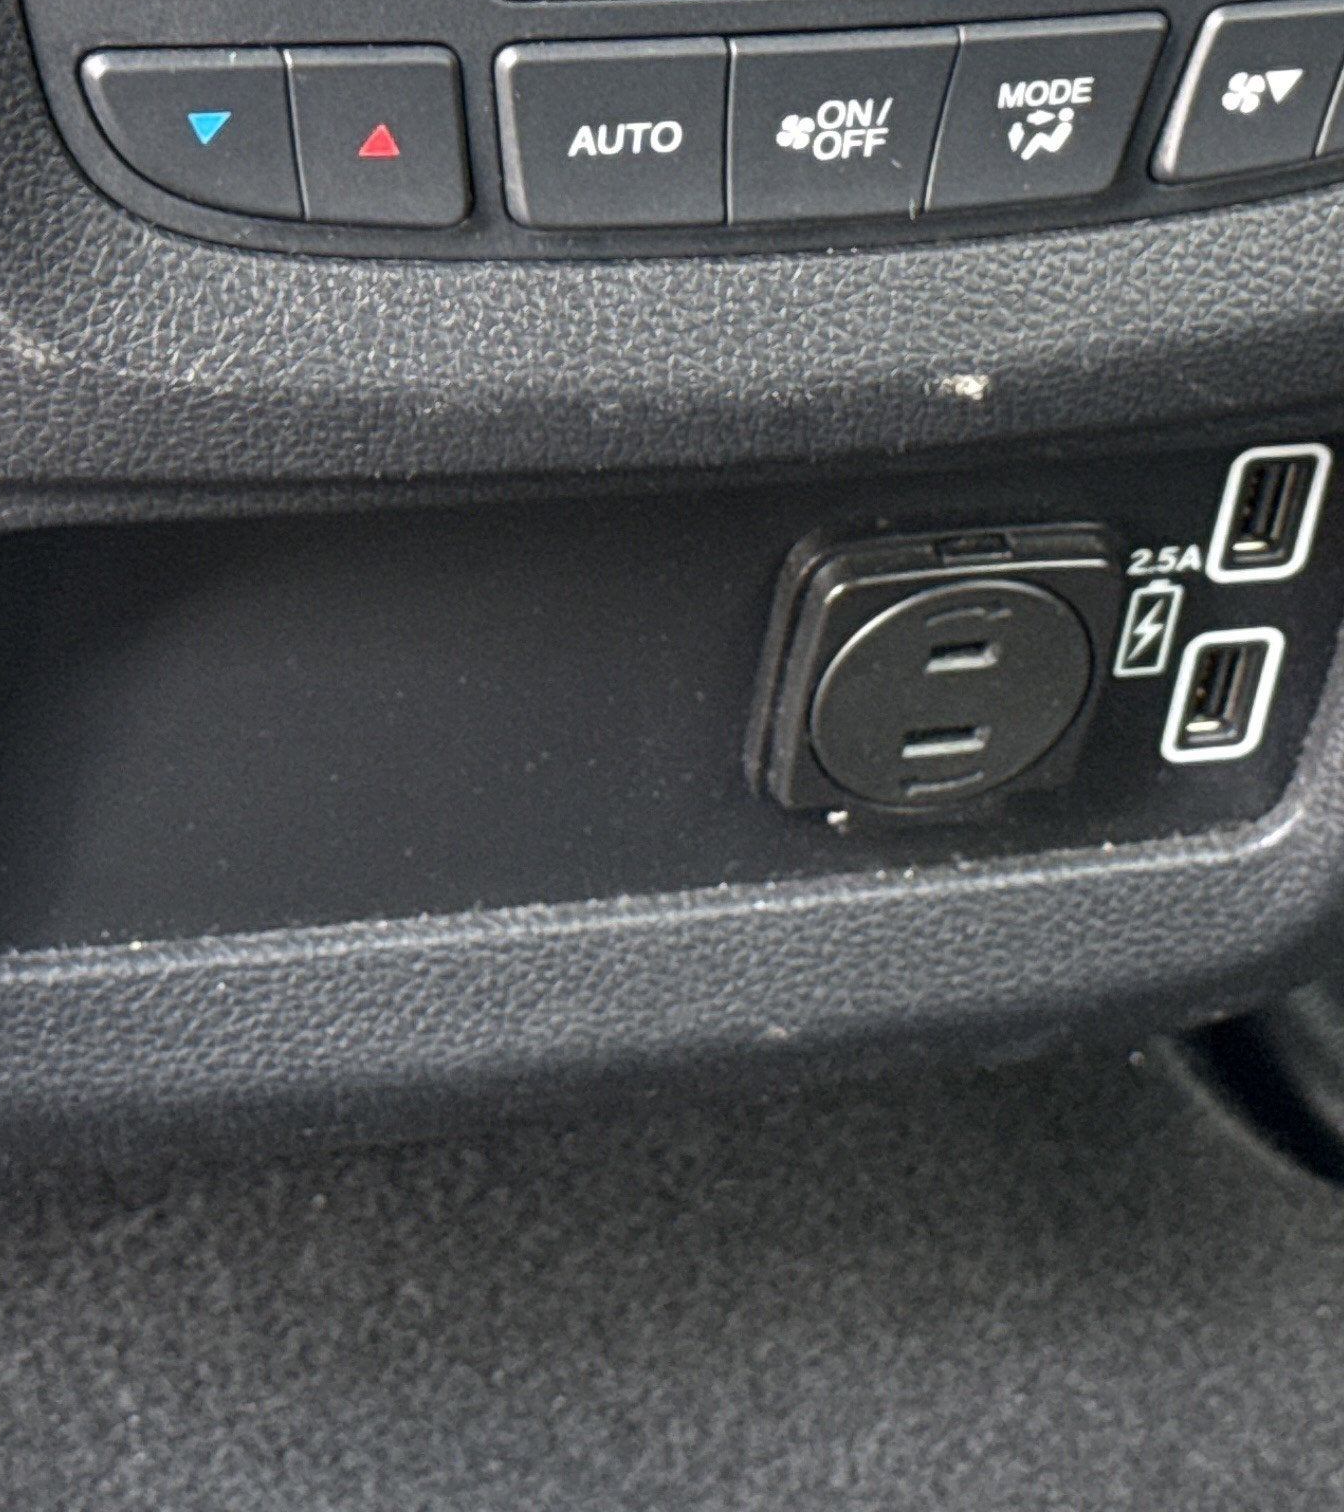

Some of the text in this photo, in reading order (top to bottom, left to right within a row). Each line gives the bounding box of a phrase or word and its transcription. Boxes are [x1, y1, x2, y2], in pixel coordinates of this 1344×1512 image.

[997, 76, 1095, 110] MODE
[816, 97, 894, 129] ON/
[567, 120, 683, 158] AUTO
[812, 127, 889, 161] OFF
[1126, 543, 1202, 576] 2.5A
